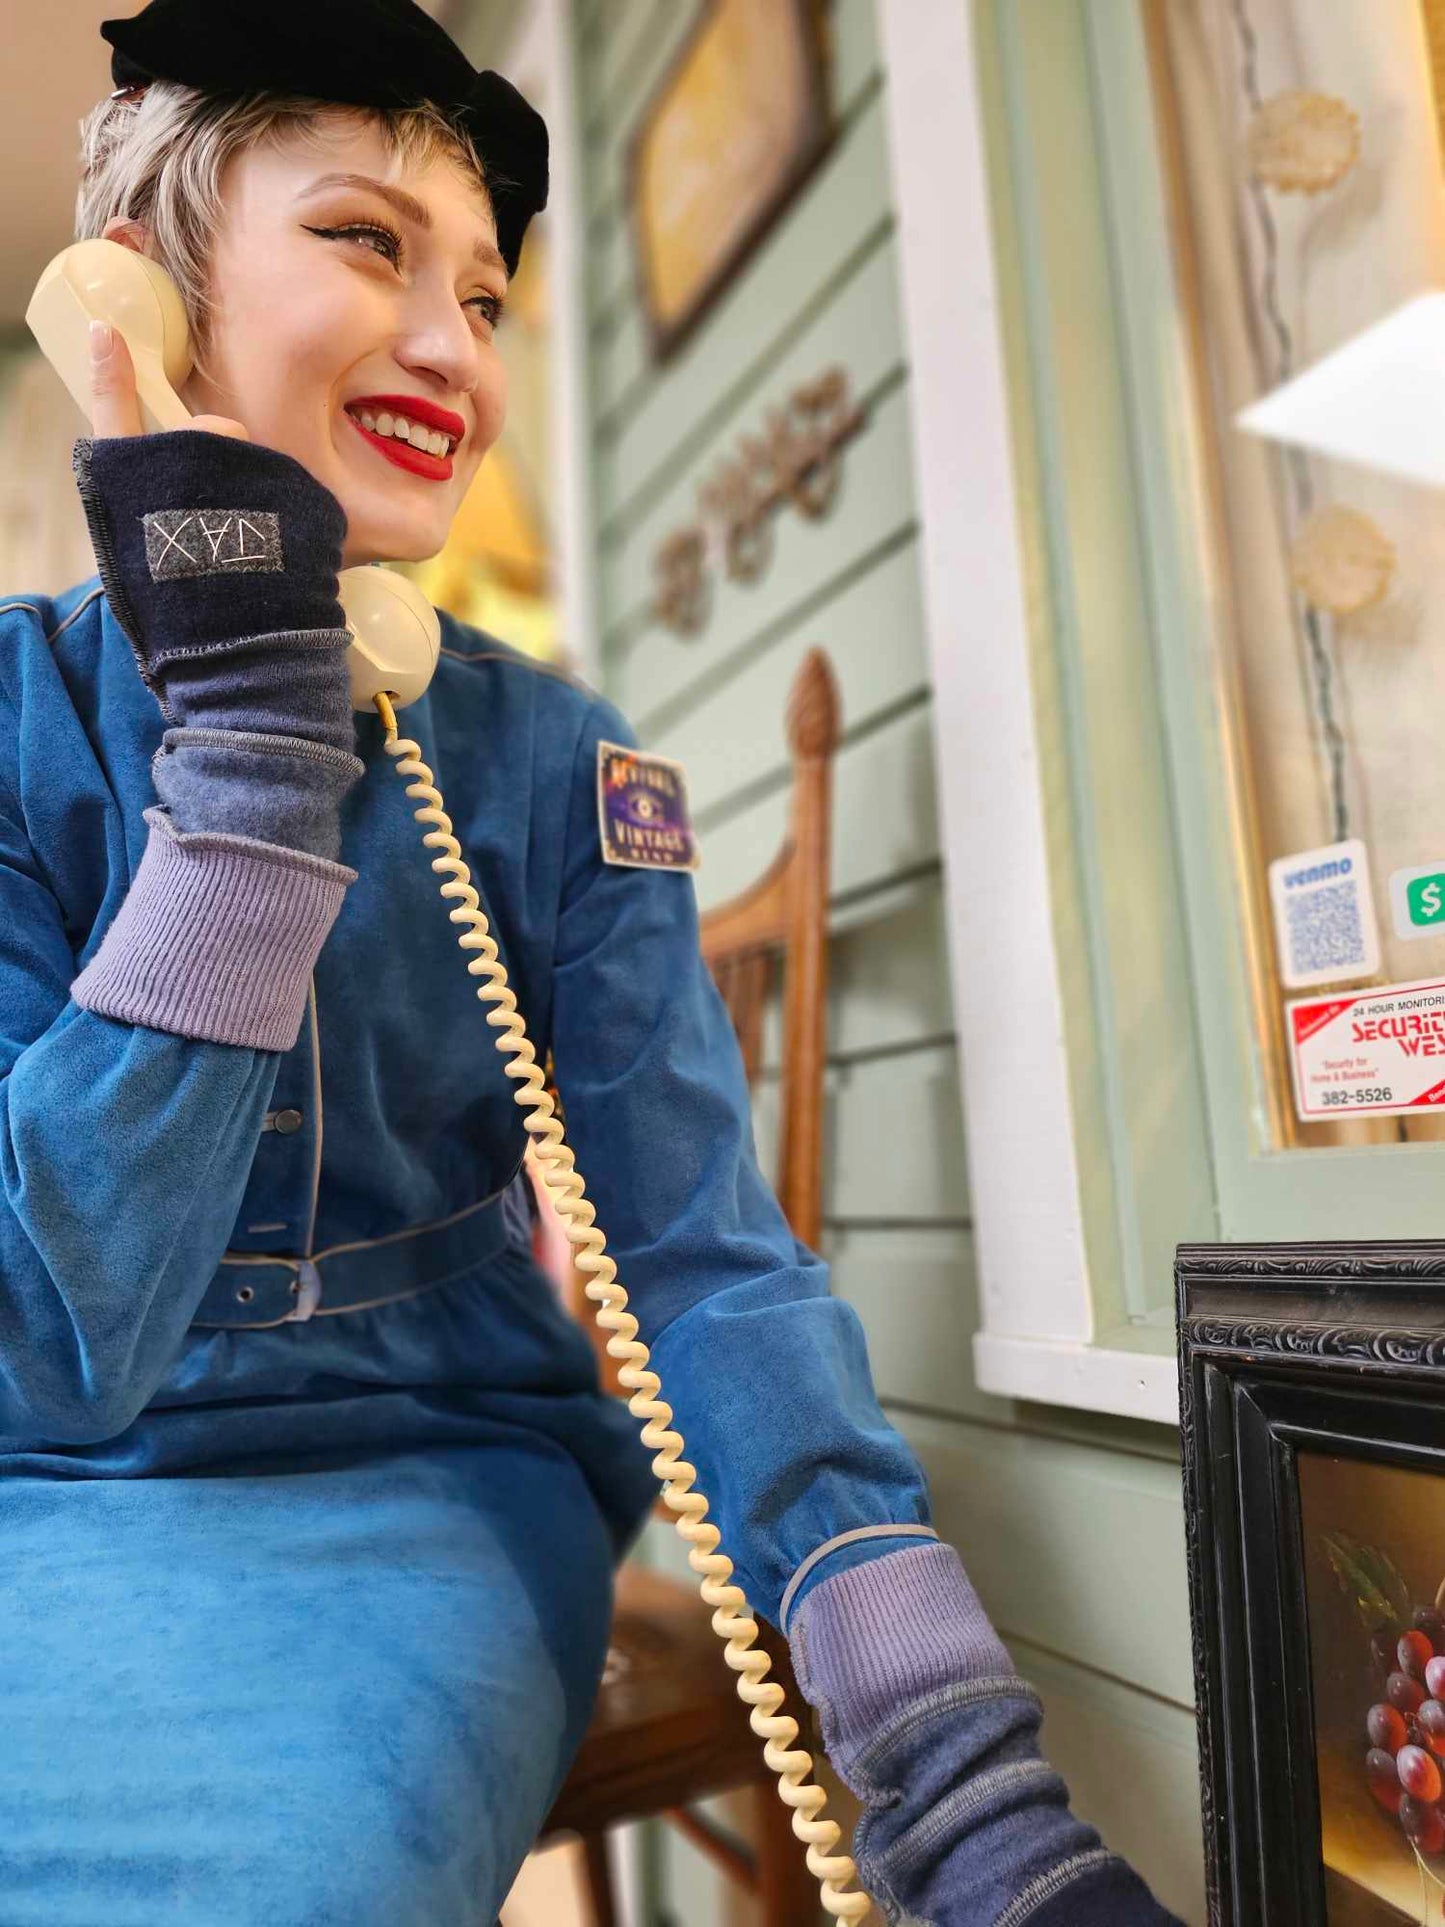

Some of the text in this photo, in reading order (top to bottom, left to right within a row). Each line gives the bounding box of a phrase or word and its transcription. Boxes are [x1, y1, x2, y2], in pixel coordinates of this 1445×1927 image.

[614, 819, 685, 851] VINTAGE
[1284, 857, 1353, 890] venmo
[1352, 1006, 1365, 1017] 24
[1368, 1002, 1395, 1015] HOUR
[1351, 1010, 1445, 1043] SECURIT
[1356, 1056, 1368, 1066] for
[1321, 1086, 1393, 1106] 382-5526
